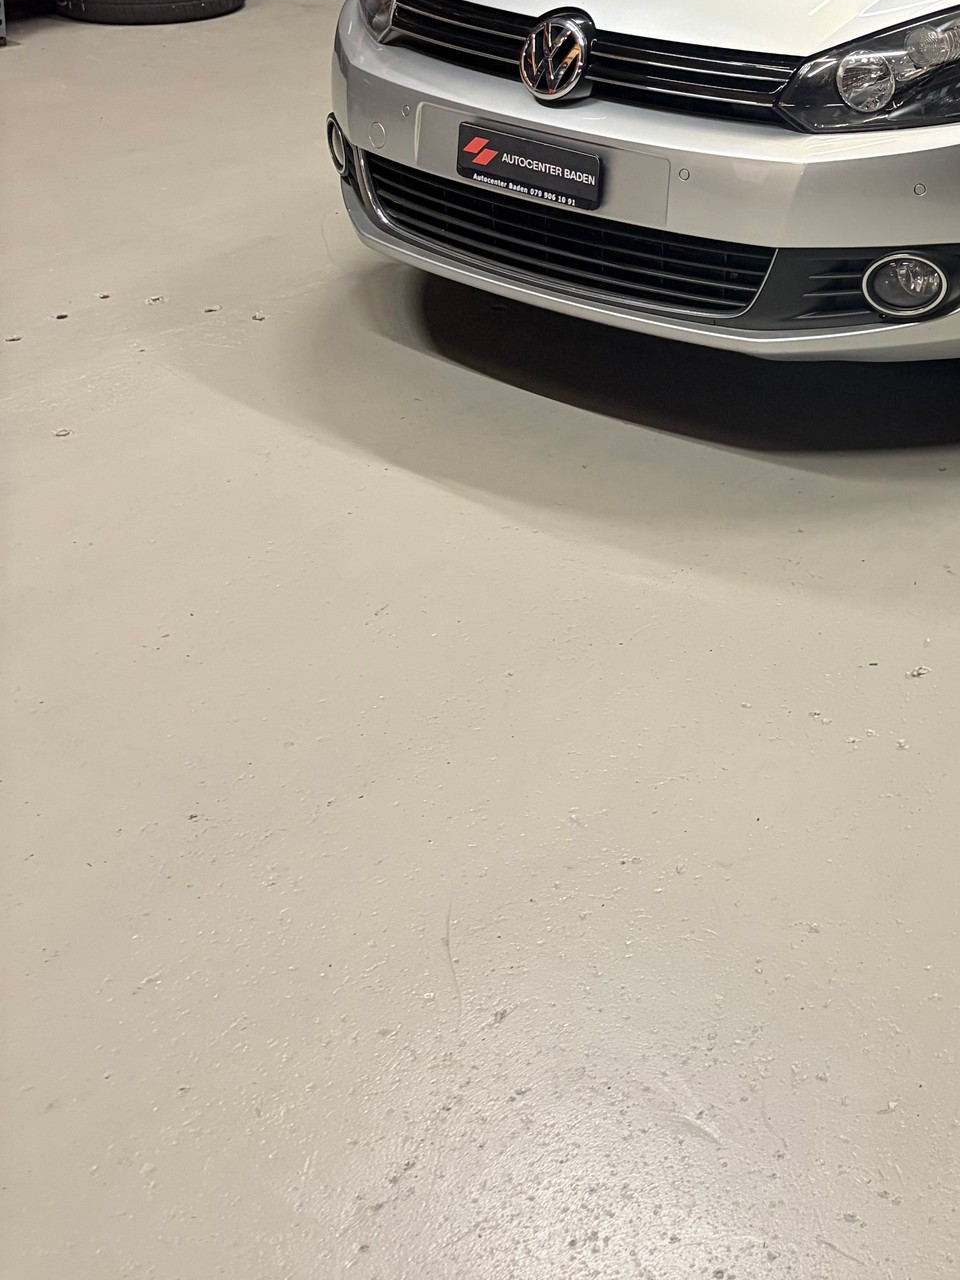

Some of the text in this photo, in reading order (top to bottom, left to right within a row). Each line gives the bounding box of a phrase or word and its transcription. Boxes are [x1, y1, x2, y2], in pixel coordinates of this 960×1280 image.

[501, 152, 596, 186] AUTOCENTER BADEN
[473, 172, 576, 206] Autocenter Baden 079 906 10 91
